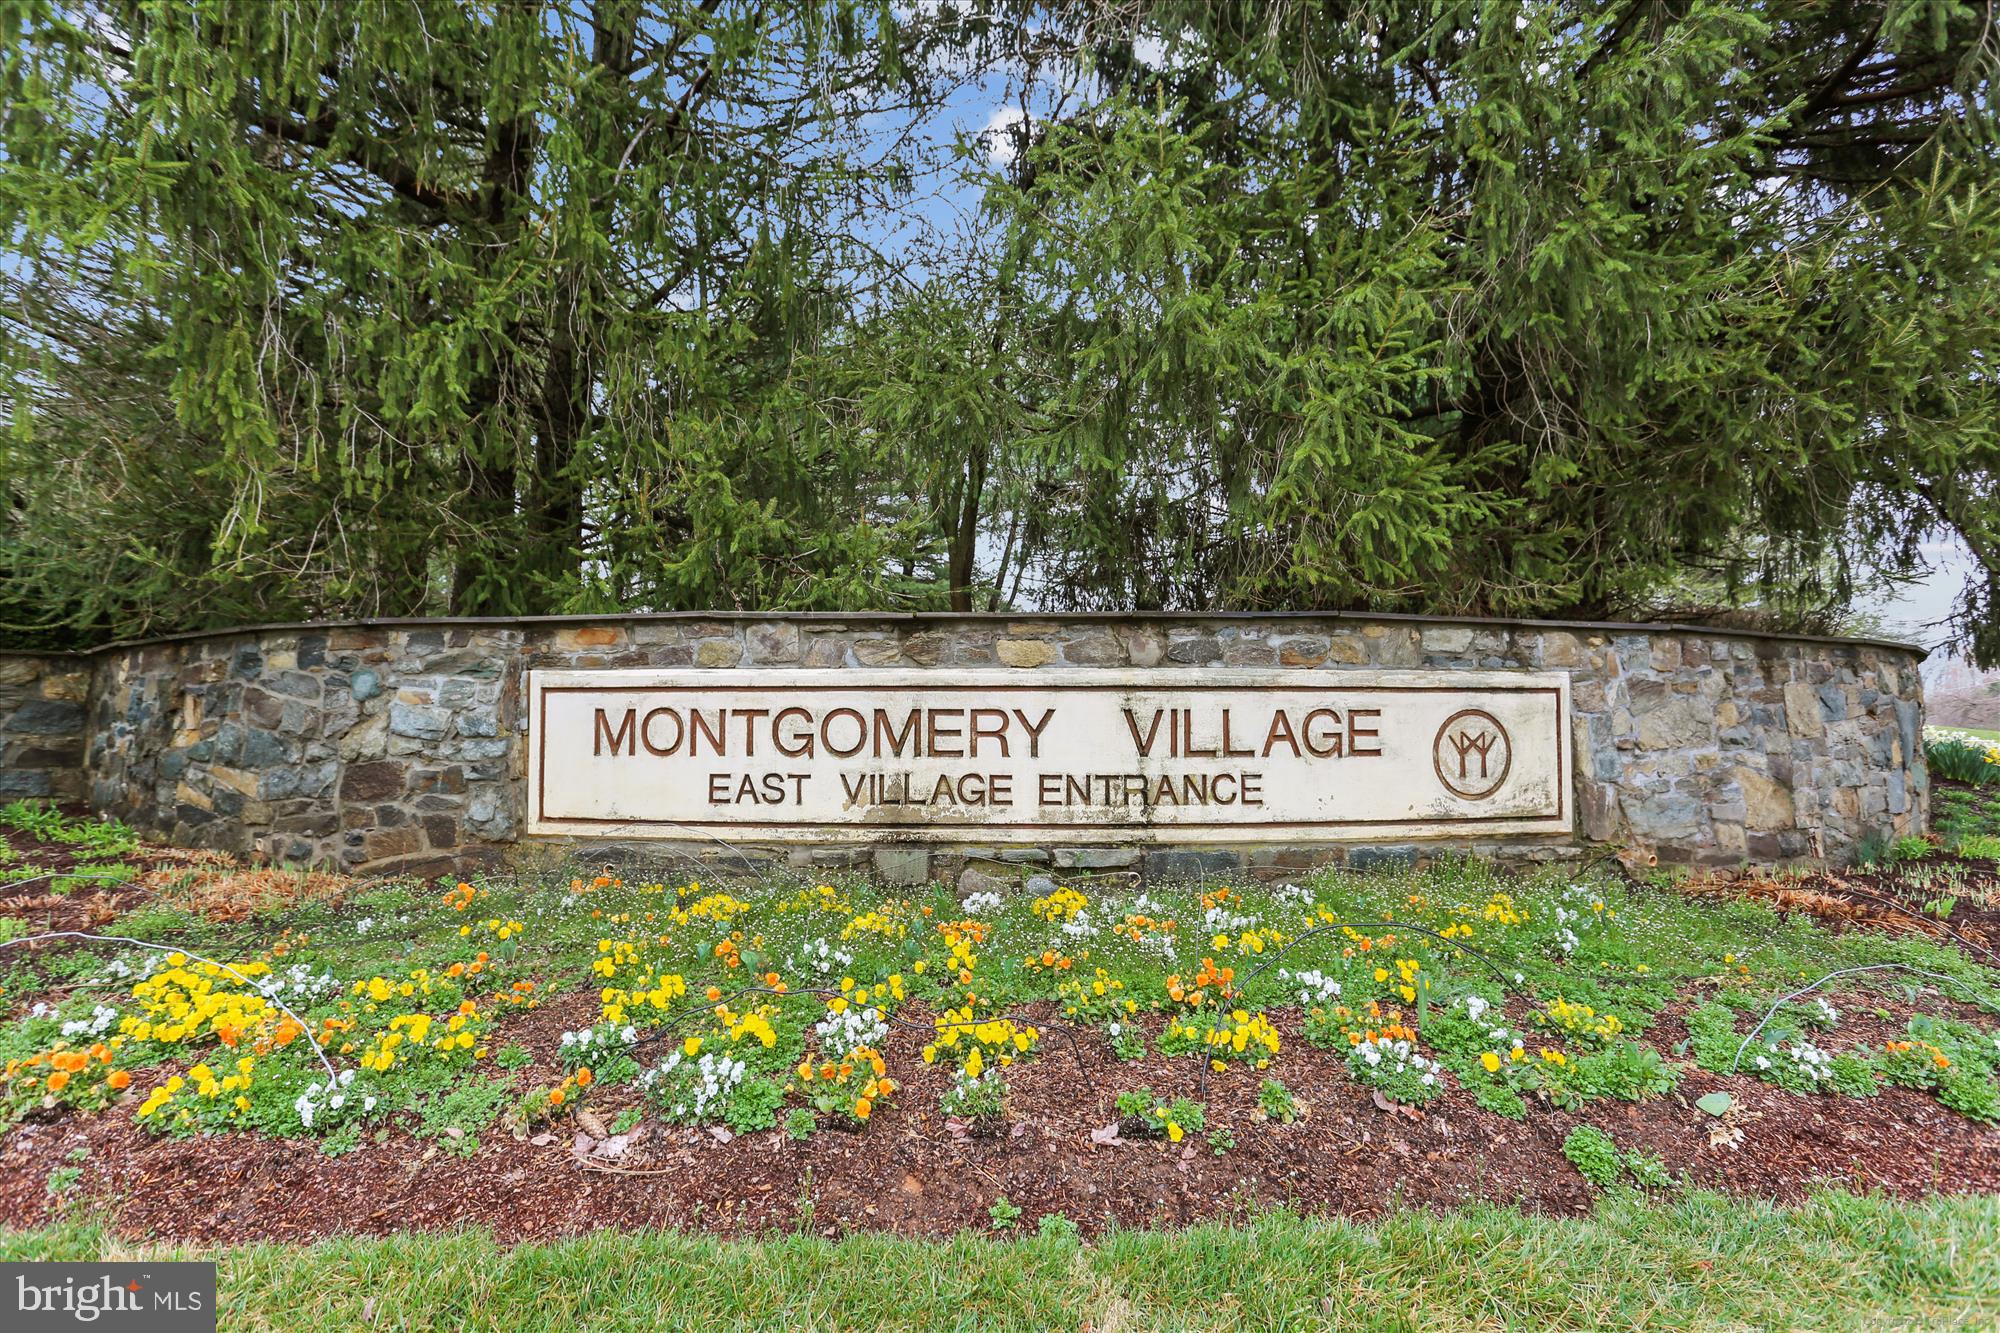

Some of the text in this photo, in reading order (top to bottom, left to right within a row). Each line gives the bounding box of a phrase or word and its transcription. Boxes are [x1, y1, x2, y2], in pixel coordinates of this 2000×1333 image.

[594, 706, 1383, 759] MONTGOMERY VILLAGE
[709, 773, 1263, 807] EAST VILLAGE ENTRANCE
